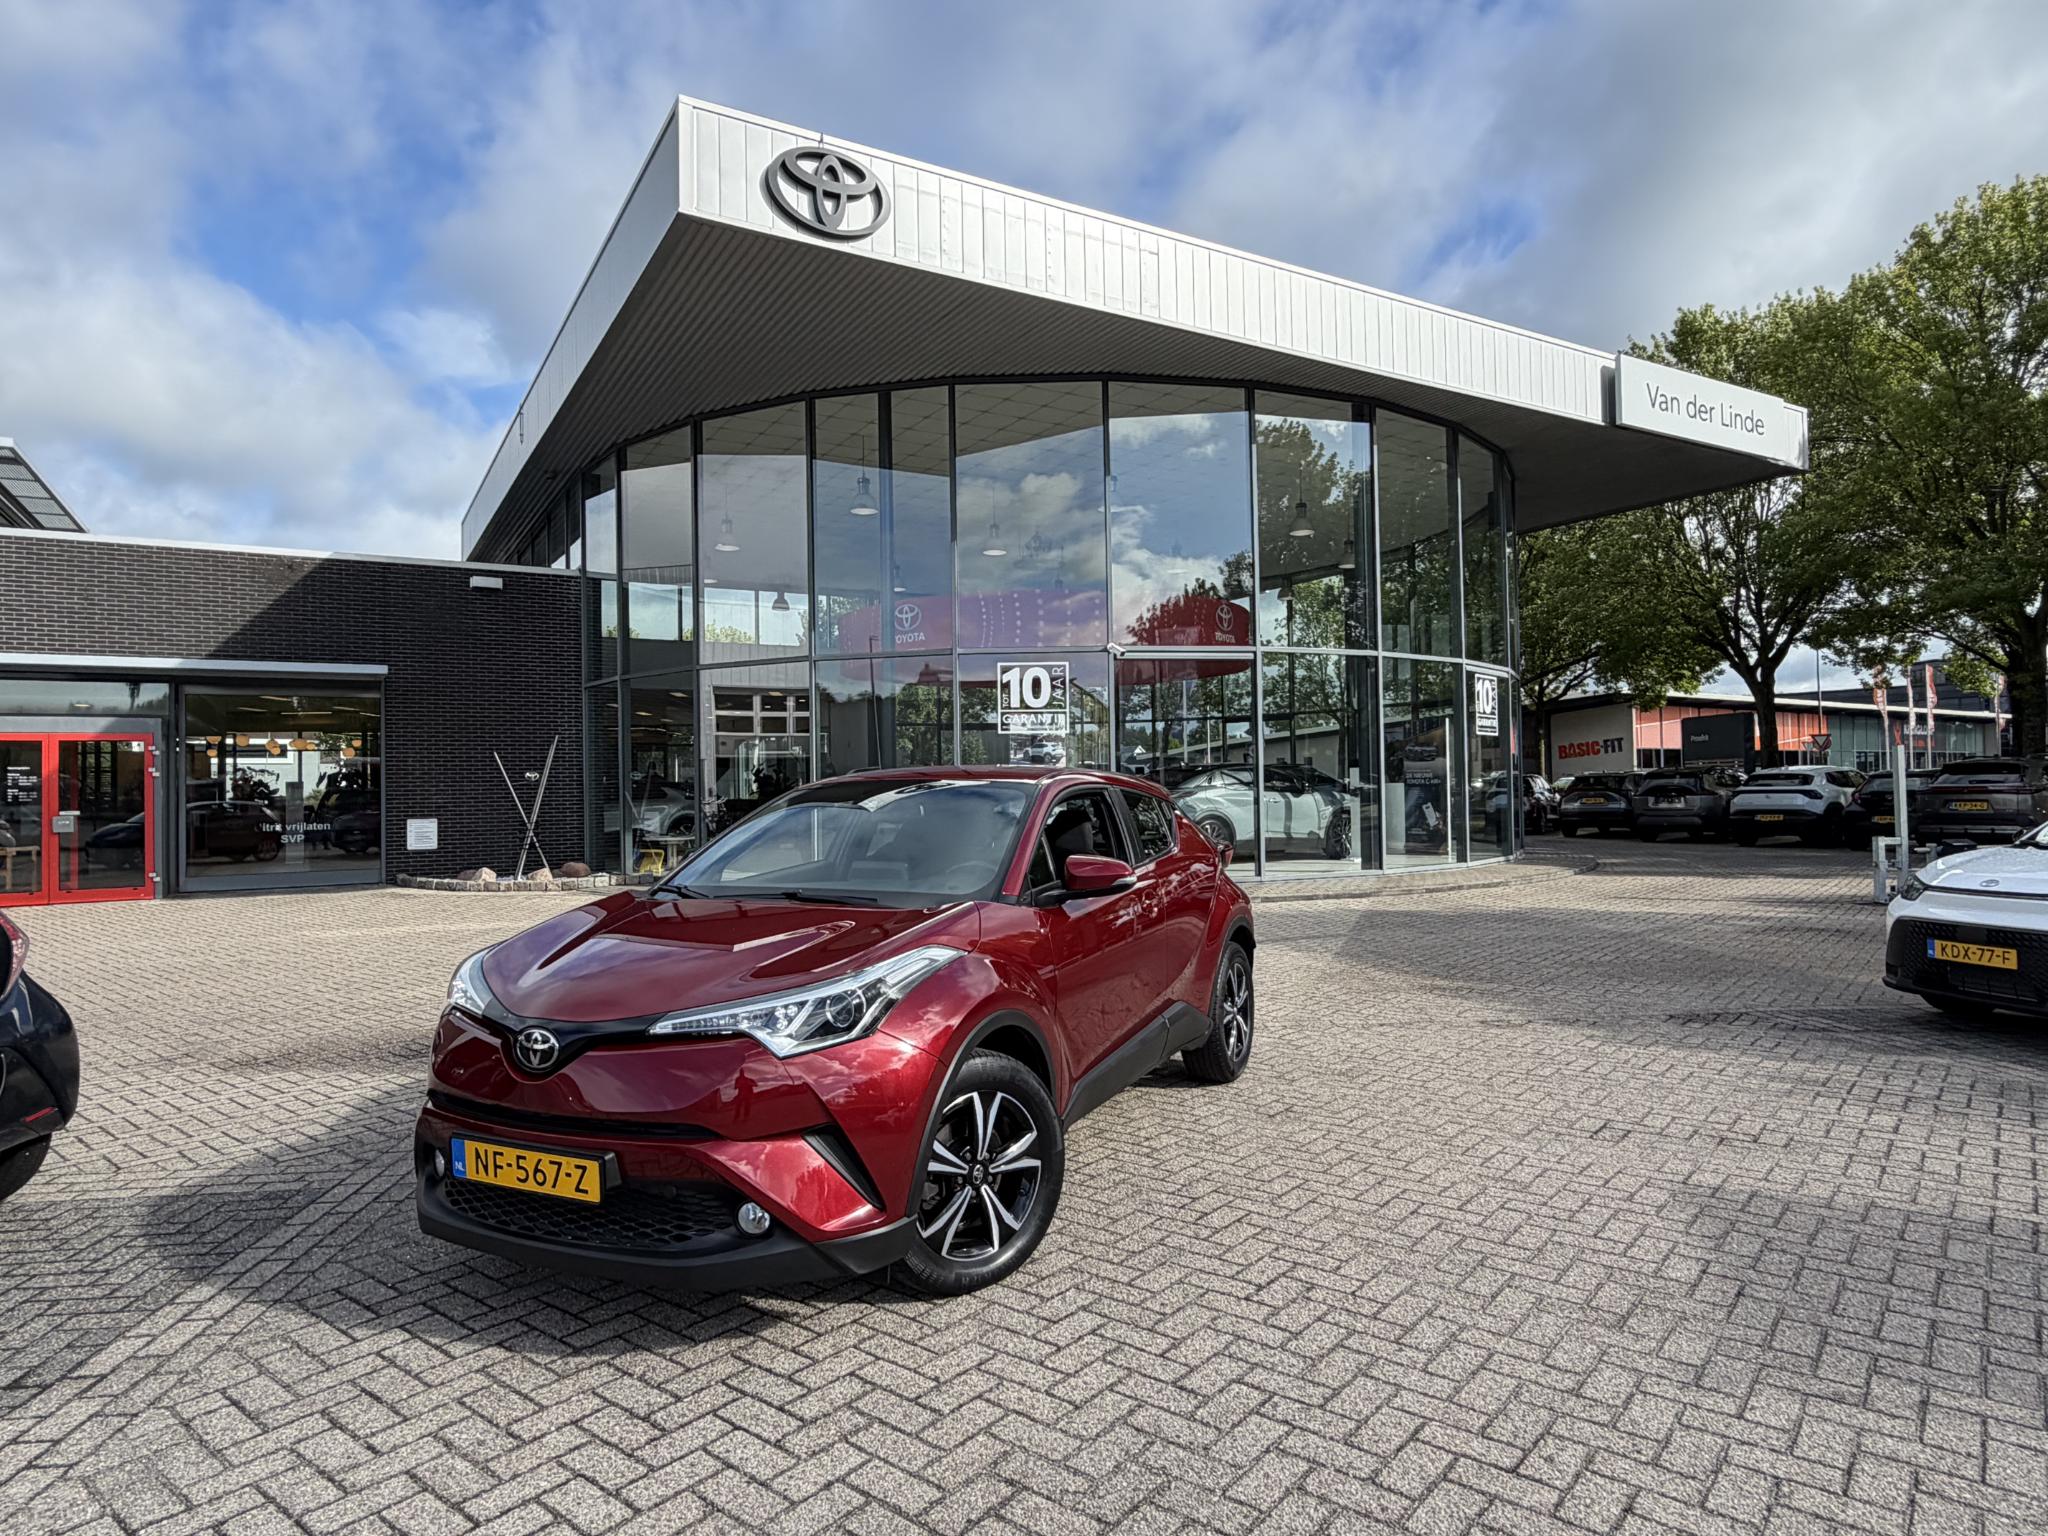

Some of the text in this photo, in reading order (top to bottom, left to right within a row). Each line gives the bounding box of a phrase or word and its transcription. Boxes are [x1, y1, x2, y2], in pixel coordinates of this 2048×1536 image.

[1646, 382, 1765, 436] Van der Linde
[896, 632, 926, 644] OYOTA
[1003, 667, 1051, 708] 10
[1052, 667, 1064, 708] JAAR
[1477, 679, 1492, 714] 10
[280, 834, 305, 843] SVP
[285, 822, 331, 833] vrijlaten
[1940, 943, 2011, 964] KDX-77-F
[455, 1147, 589, 1194] NL NF-567-Z
